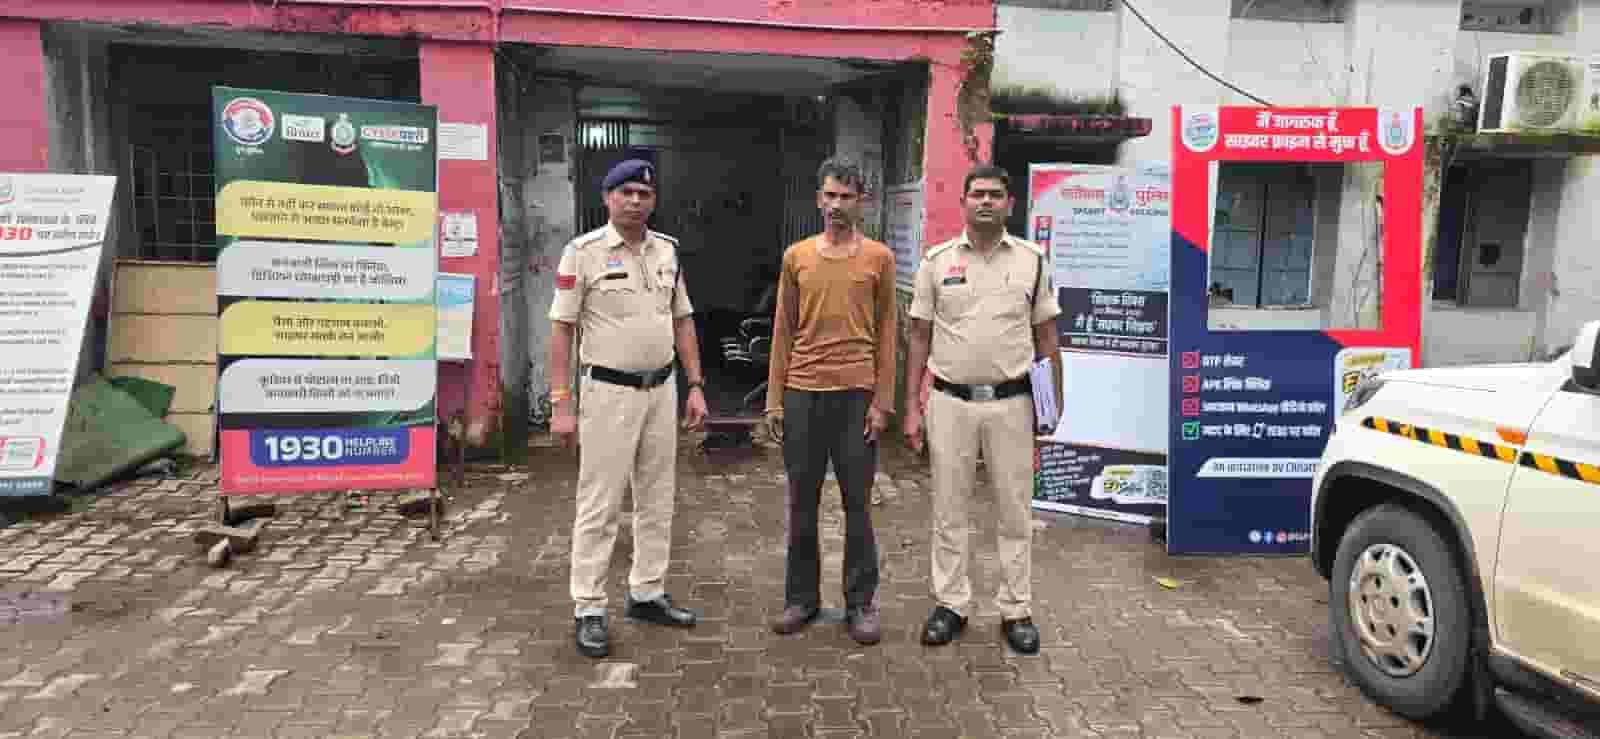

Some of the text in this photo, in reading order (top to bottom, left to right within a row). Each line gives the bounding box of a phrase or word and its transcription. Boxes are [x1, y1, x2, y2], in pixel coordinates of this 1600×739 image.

[265, 435, 343, 461] 1930
[345, 437, 395, 448] HELPLINE
[344, 447, 396, 457] NUMBER
